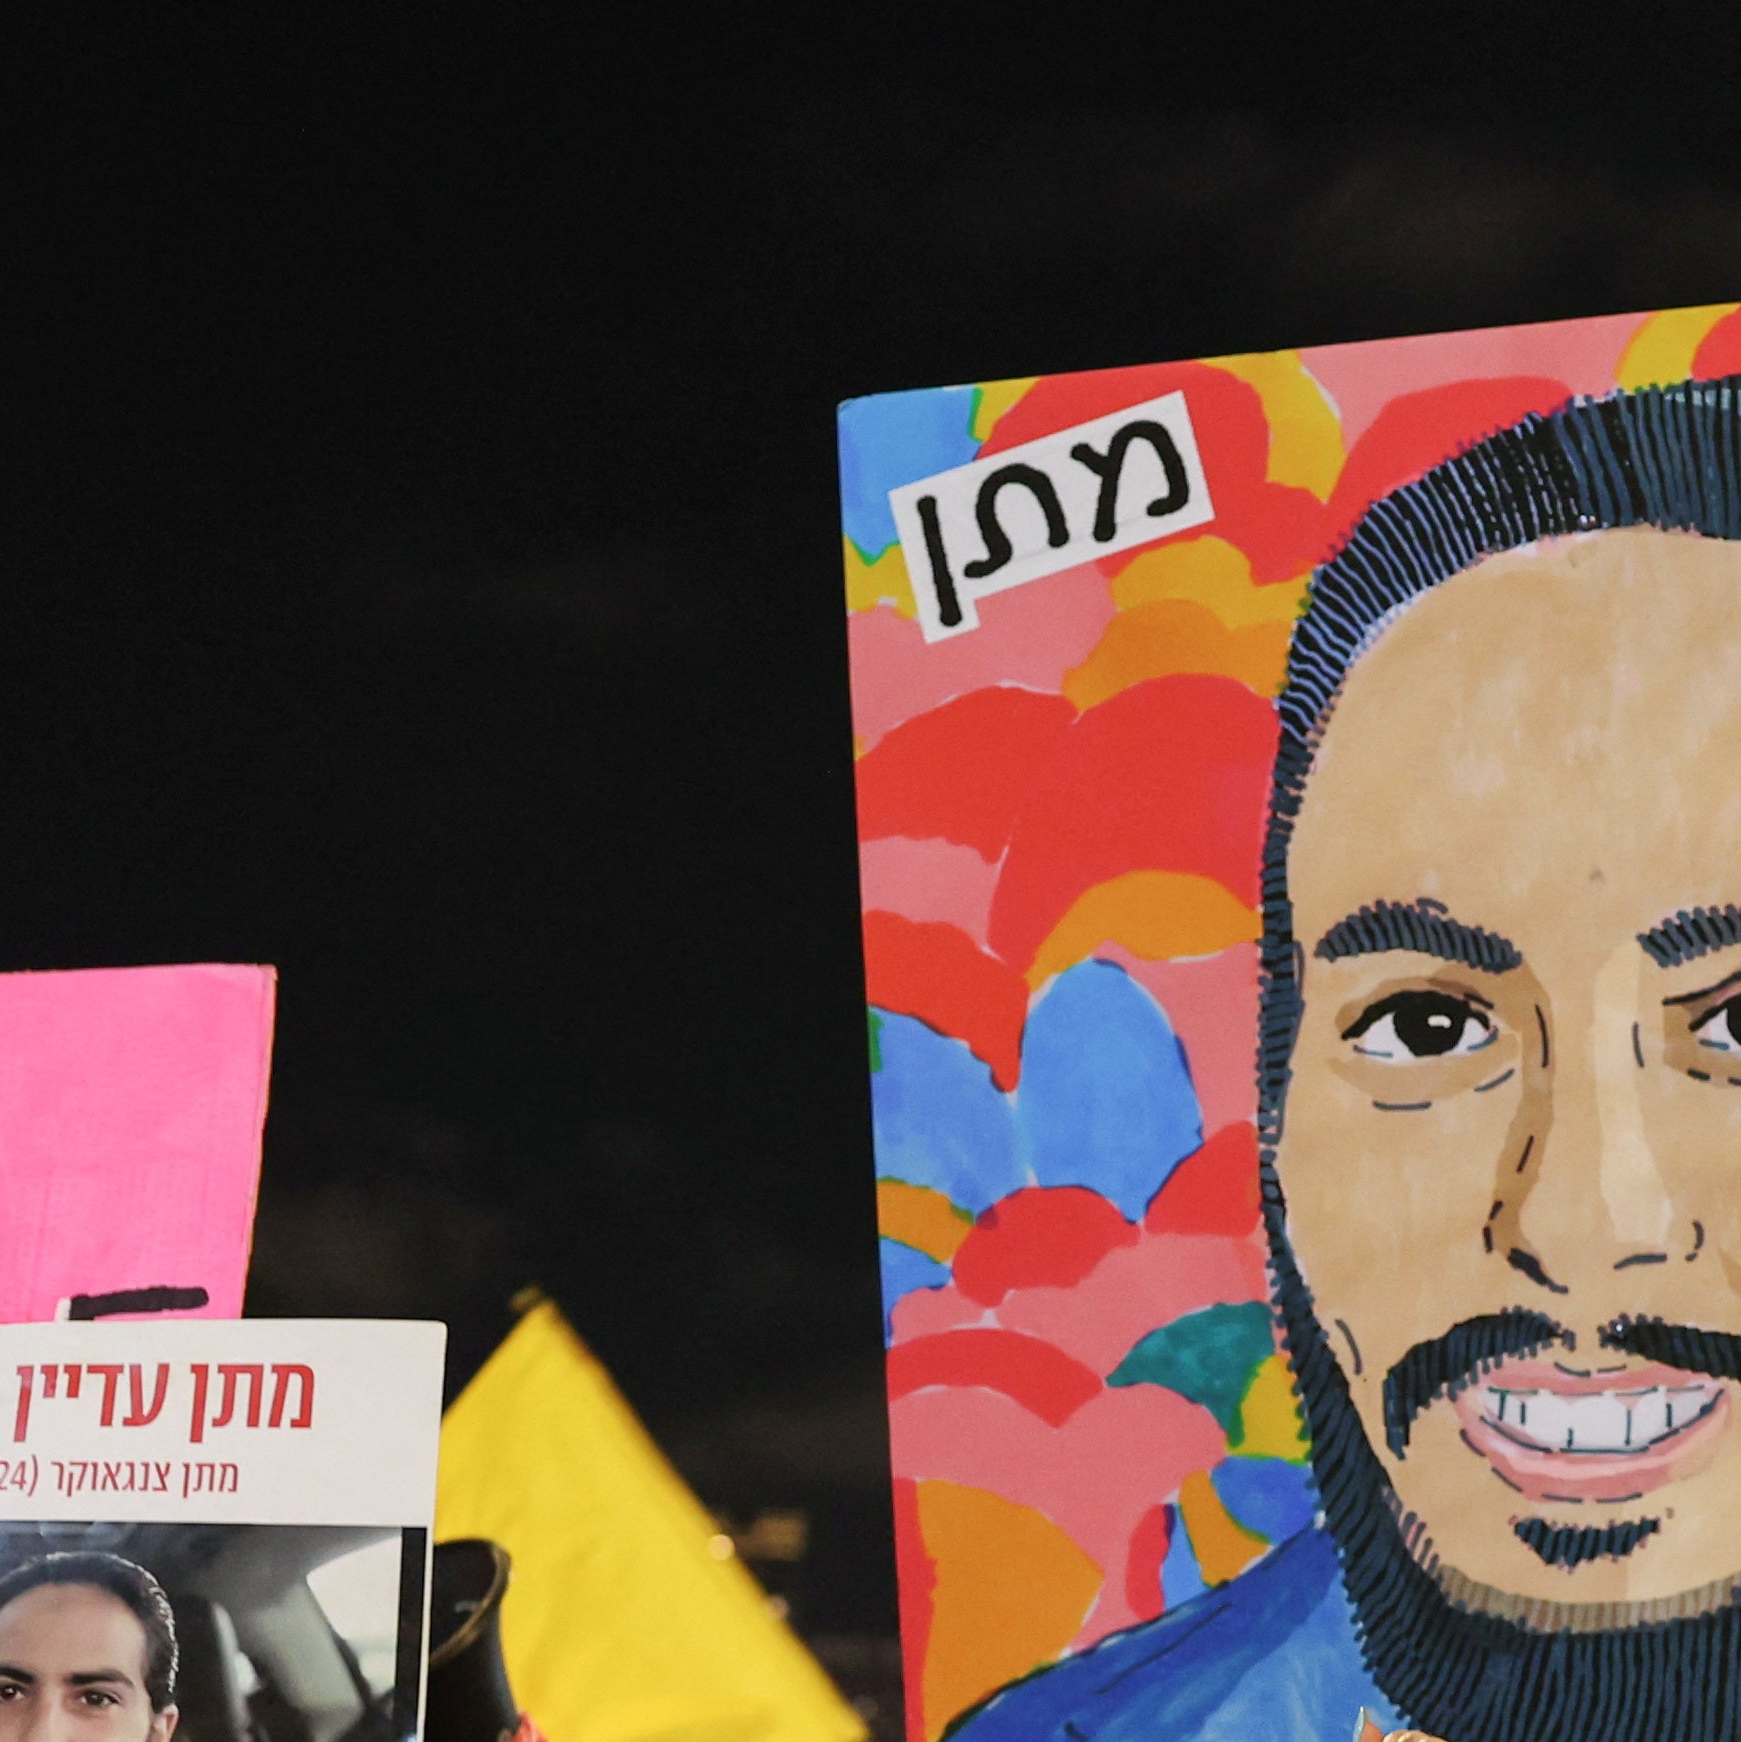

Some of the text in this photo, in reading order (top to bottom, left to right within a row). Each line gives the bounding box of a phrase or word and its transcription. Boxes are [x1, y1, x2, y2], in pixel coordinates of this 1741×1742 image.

[916, 419, 1190, 628] מתן
[13, 1363, 170, 1443] עדיין
[189, 1363, 315, 1443] מתן
[51, 1460, 171, 1498] צנגאוקר
[182, 1462, 240, 1499] מתן
